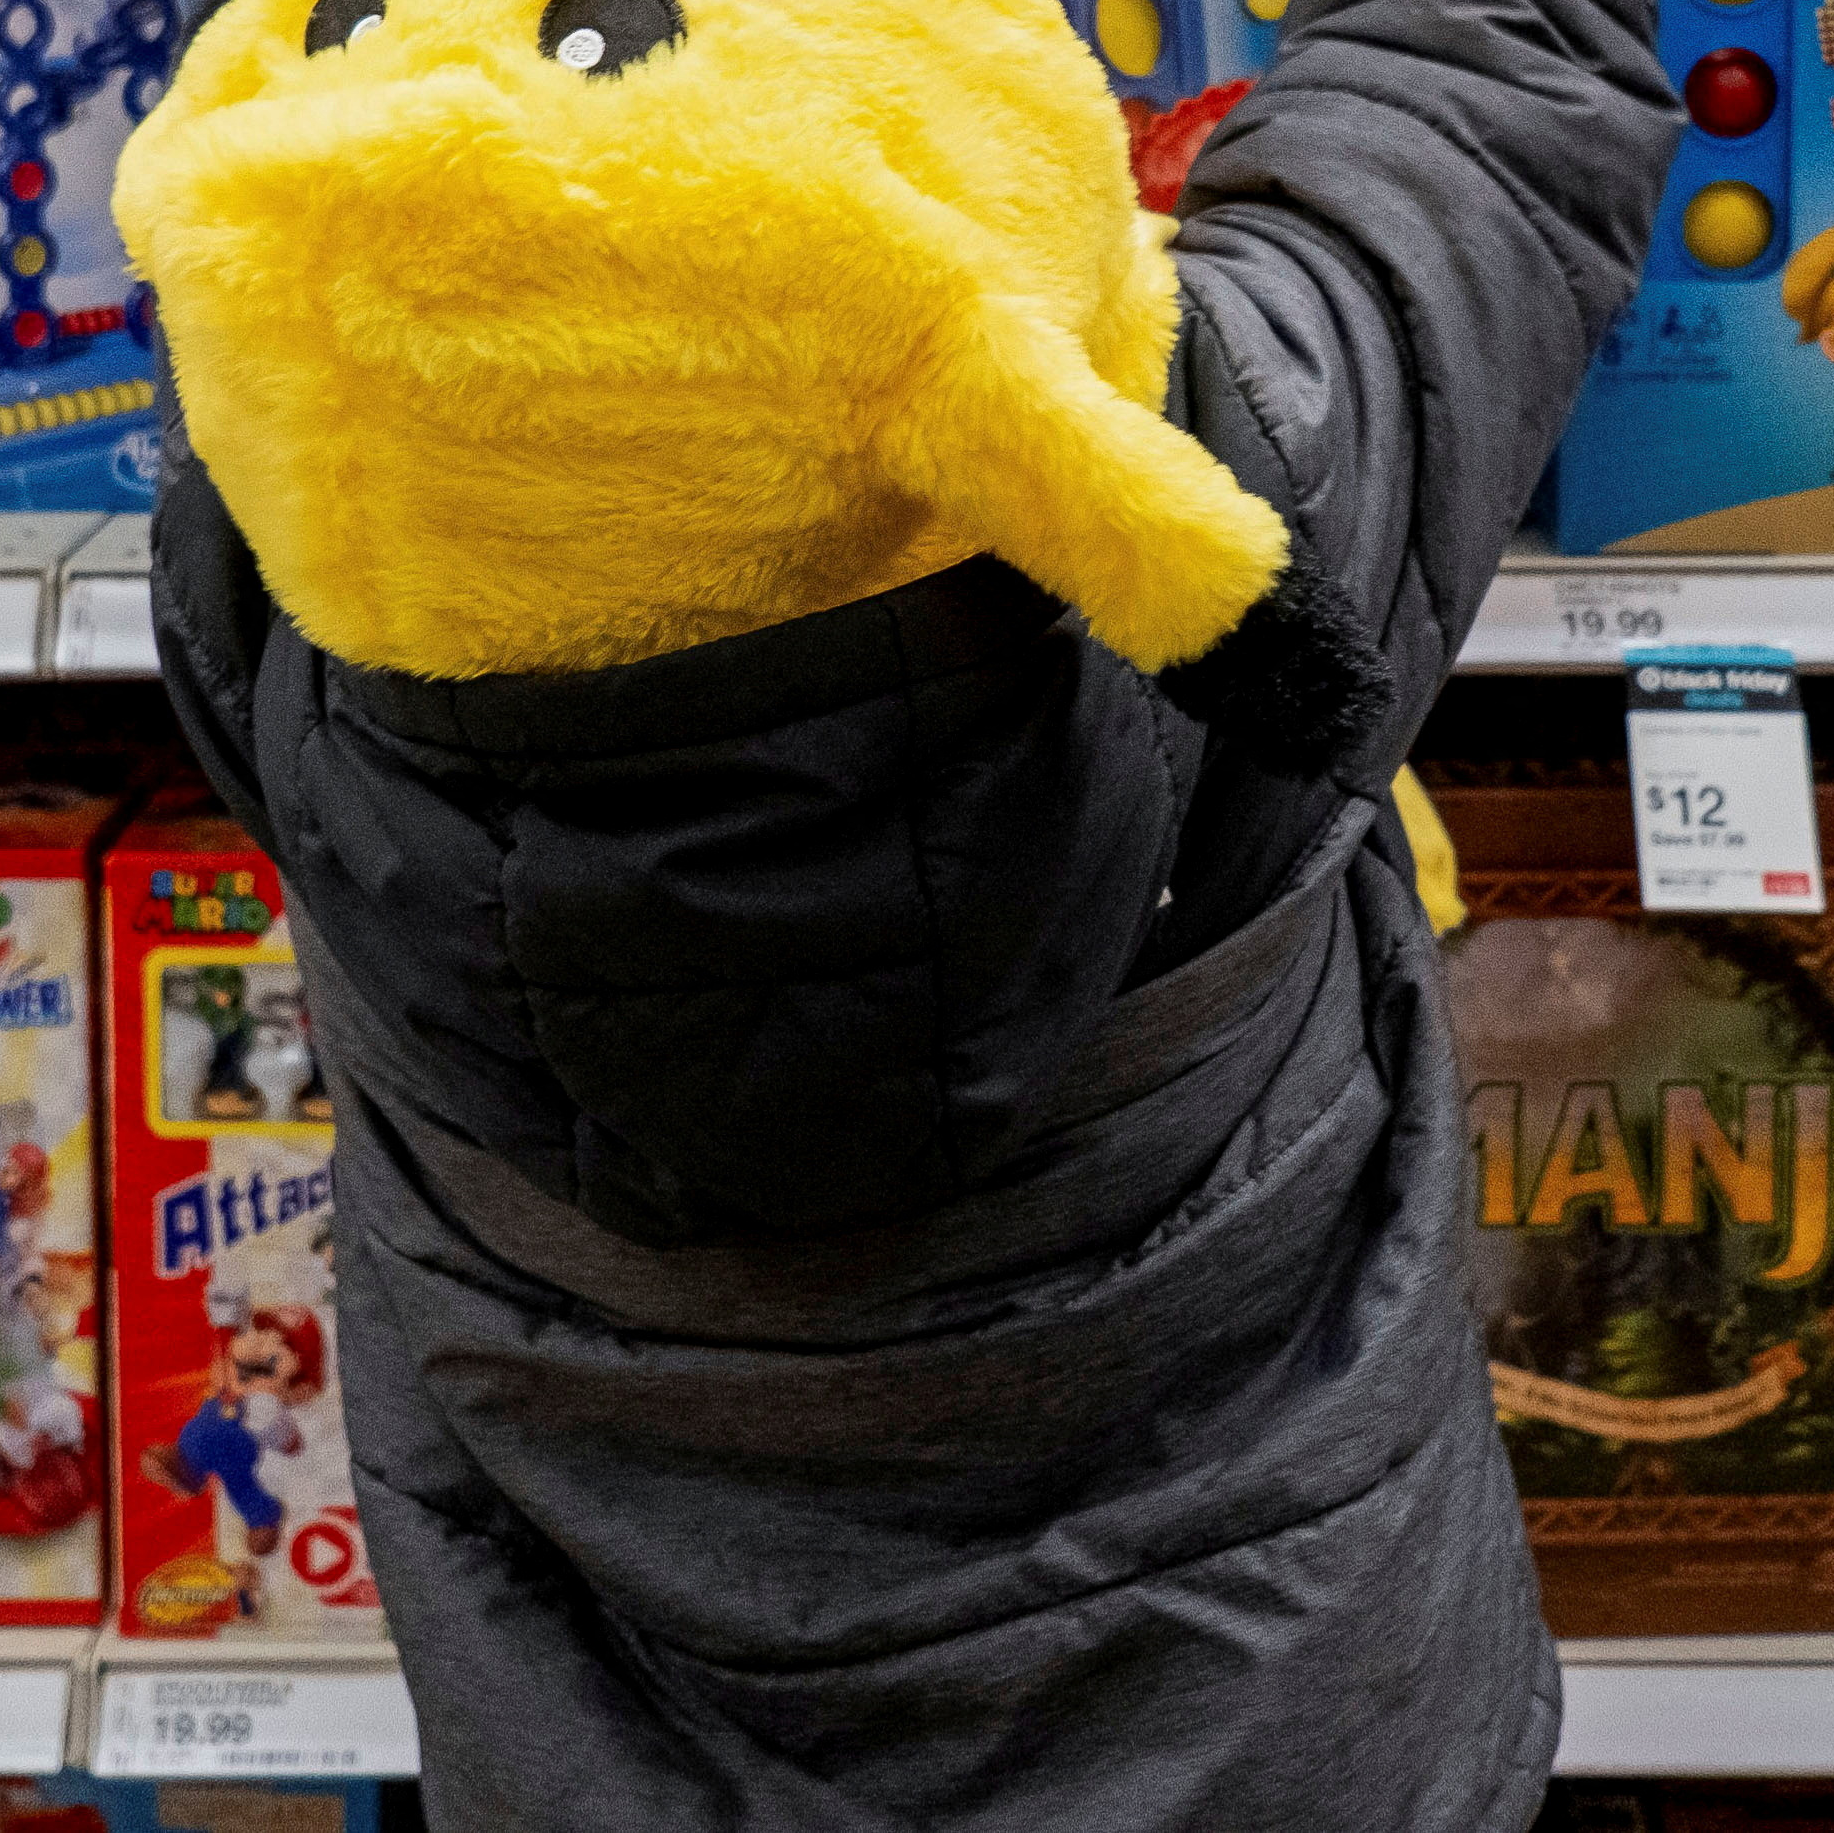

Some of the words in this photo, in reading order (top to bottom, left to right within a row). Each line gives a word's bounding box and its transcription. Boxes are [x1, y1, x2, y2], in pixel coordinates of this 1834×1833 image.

[1561, 607, 1665, 638] 19.99
[1645, 785, 1727, 829] $12
[151, 1712, 253, 1744] 19.99
